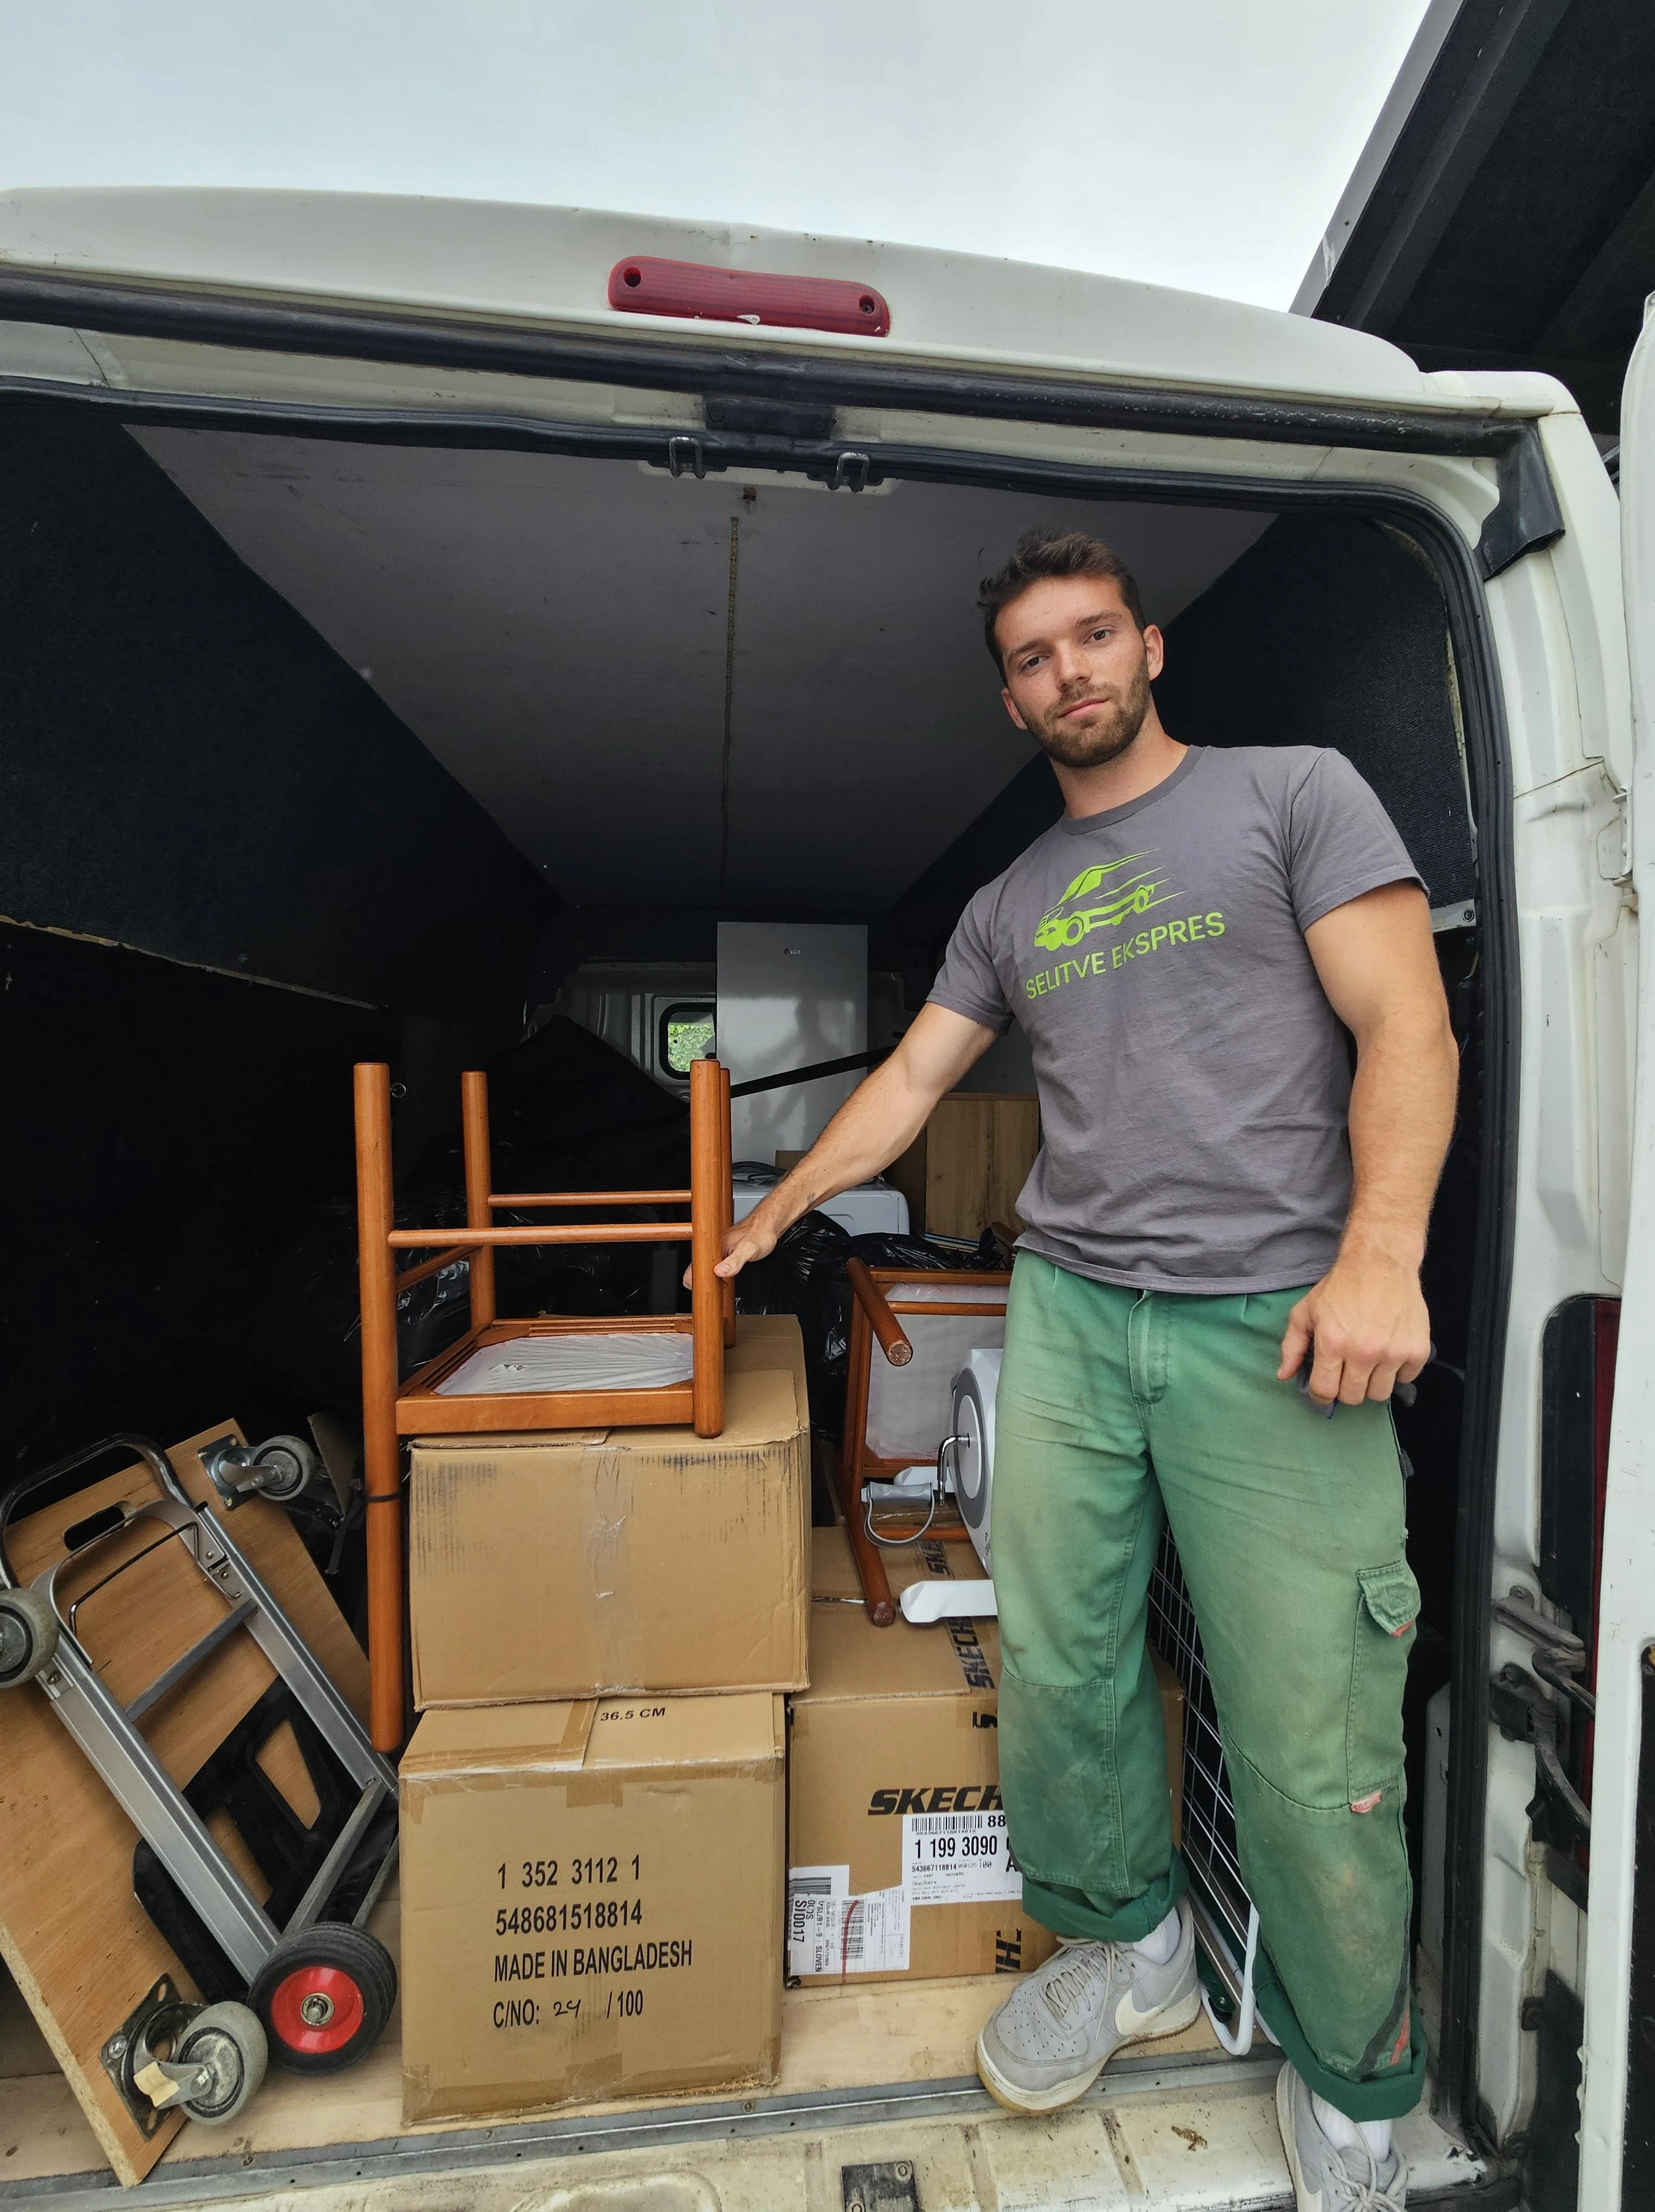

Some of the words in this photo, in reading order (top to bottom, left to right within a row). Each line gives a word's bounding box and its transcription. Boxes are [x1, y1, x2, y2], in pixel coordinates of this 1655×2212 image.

[1026, 951, 1106, 999] SELITVE
[1112, 912, 1225, 969] EKSPRES
[600, 1710, 634, 1721] 36.5
[639, 1707, 665, 1718] CM
[915, 1839, 921, 1859] 1
[930, 1837, 956, 1858] 199
[961, 1835, 997, 1856] 3090
[498, 1863, 506, 1889] 1
[522, 1860, 558, 1887] 352
[571, 1856, 618, 1885] 3112
[631, 1854, 639, 1880] 1
[912, 1863, 956, 1872] 543667118814
[496, 1898, 643, 1936] 548681518814
[495, 1952, 545, 1982] MADE
[551, 1944, 568, 1977] IN
[574, 1939, 692, 1975] BANGLADESH
[493, 1999, 539, 2028] C/NO:
